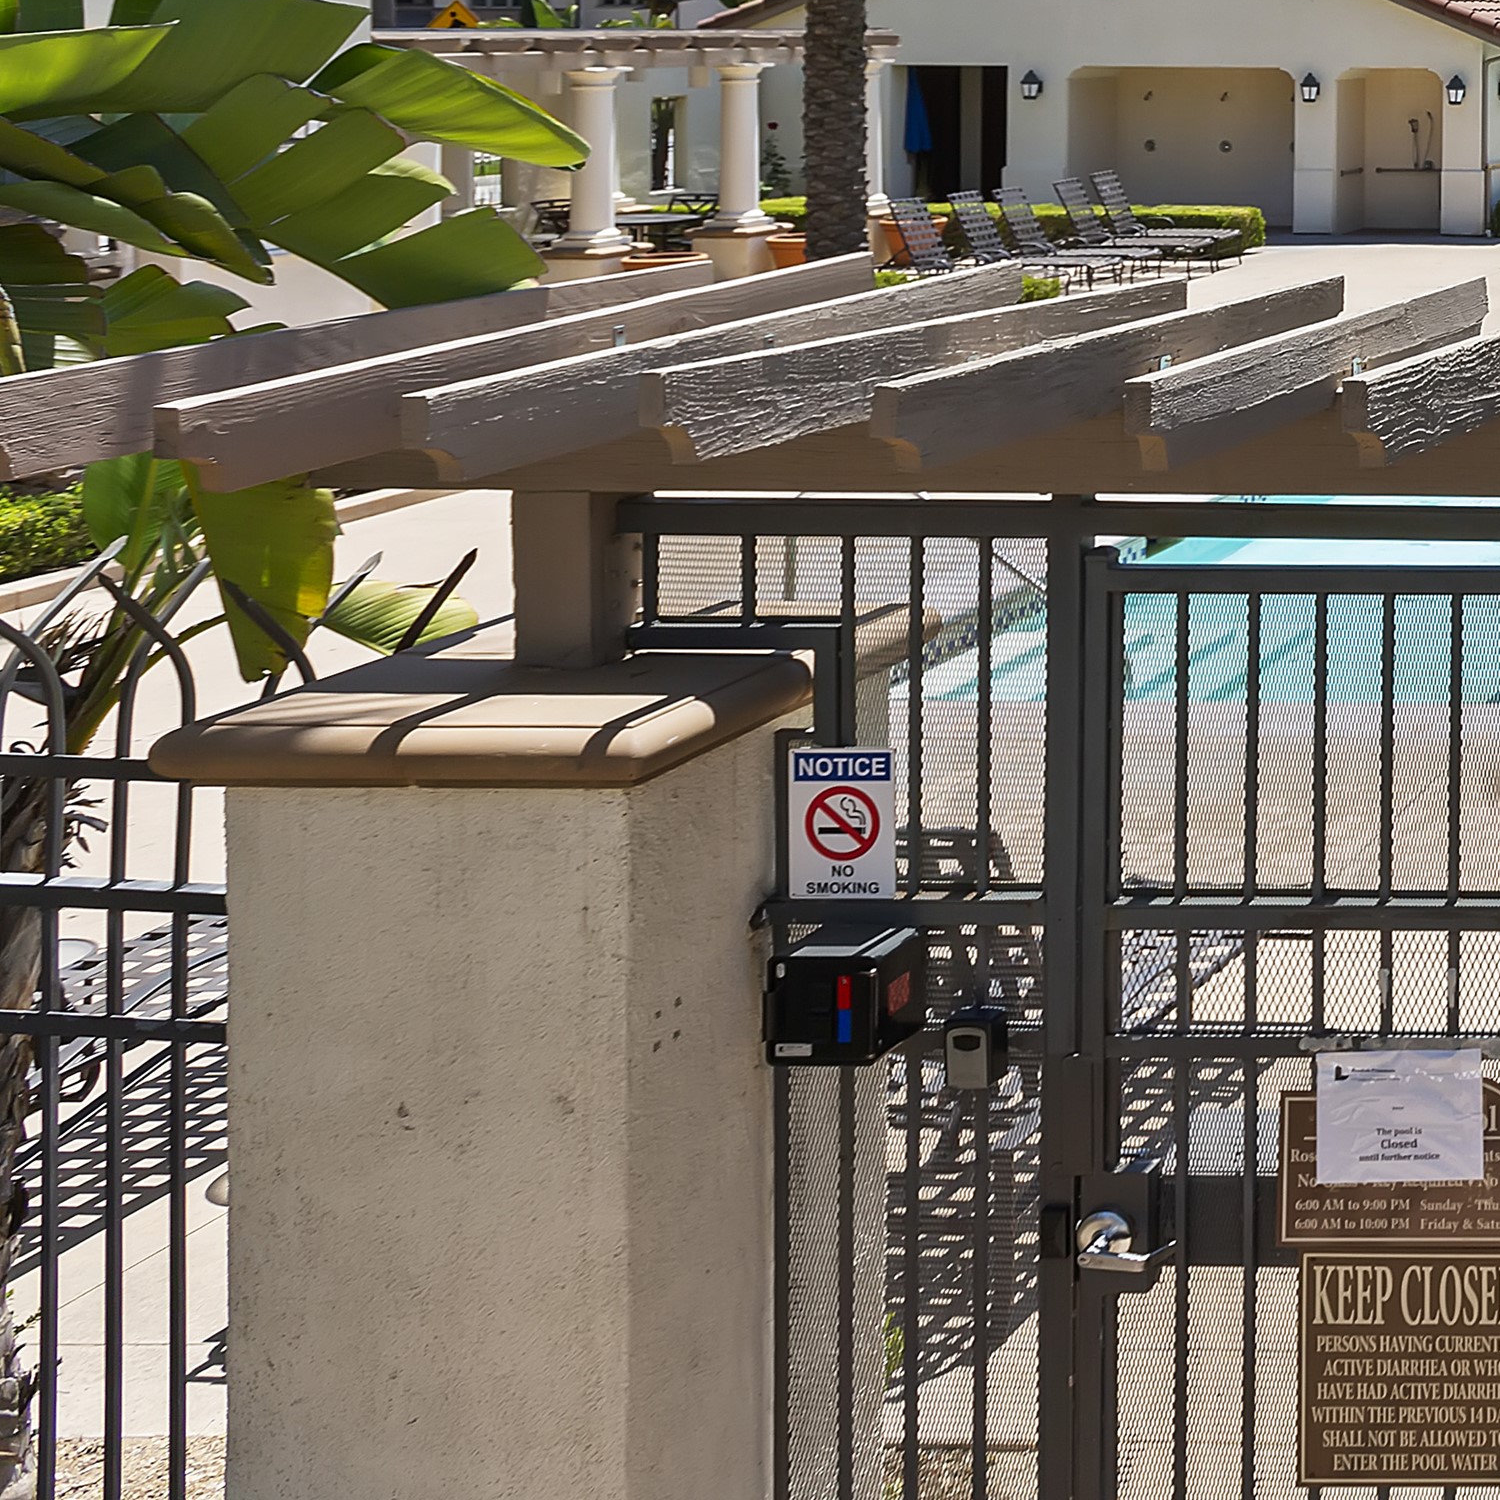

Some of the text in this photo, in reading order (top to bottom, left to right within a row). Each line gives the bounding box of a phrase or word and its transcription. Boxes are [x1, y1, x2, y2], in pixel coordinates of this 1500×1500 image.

[798, 758, 886, 776] NOTICE
[831, 865, 854, 877] NO
[806, 882, 880, 895] SMOKING
[1376, 1127, 1422, 1137] The pool is
[1381, 1138, 1418, 1149] Closed
[1358, 1153, 1379, 1162] until
[1381, 1153, 1411, 1161] further
[1298, 1174, 1316, 1187] No
[1478, 1173, 1498, 1188] No
[1295, 1200, 1319, 1210] 6:00
[1323, 1200, 1345, 1210] AM
[1348, 1201, 1360, 1210] to
[1363, 1200, 1386, 1210] 9:00
[1390, 1200, 1410, 1210] PM
[1420, 1200, 1463, 1214] Sunday
[1295, 1219, 1320, 1230] 6:00
[1322, 1219, 1343, 1229] AM
[1346, 1219, 1357, 1229] to
[1360, 1219, 1386, 1230] 10:00
[1390, 1219, 1409, 1229] PM
[1420, 1218, 1458, 1232] Friday
[1462, 1219, 1473, 1230] &
[1312, 1265, 1393, 1325] KEEP
[1317, 1336, 1376, 1352] PERSONS
[1380, 1336, 1432, 1352] HAVING
[1323, 1359, 1373, 1376] ACTIVE
[1377, 1359, 1447, 1376] DIARRHEA
[1451, 1360, 1470, 1376] OR
[1317, 1383, 1354, 1399] HAVE
[1357, 1383, 1387, 1399] HAD
[1390, 1383, 1439, 1400] ACTIVE
[1312, 1406, 1365, 1423] WITHIN
[1368, 1407, 1395, 1423] THE
[1399, 1407, 1466, 1423] PREVIOUS
[1470, 1407, 1483, 1423] 14
[1322, 1430, 1365, 1447] SHALL
[1368, 1430, 1396, 1447] NOT
[1400, 1430, 1416, 1447] BE
[1420, 1430, 1486, 1447] ALLOWED
[1333, 1454, 1497, 1471] ENTER THE POOL WATER
